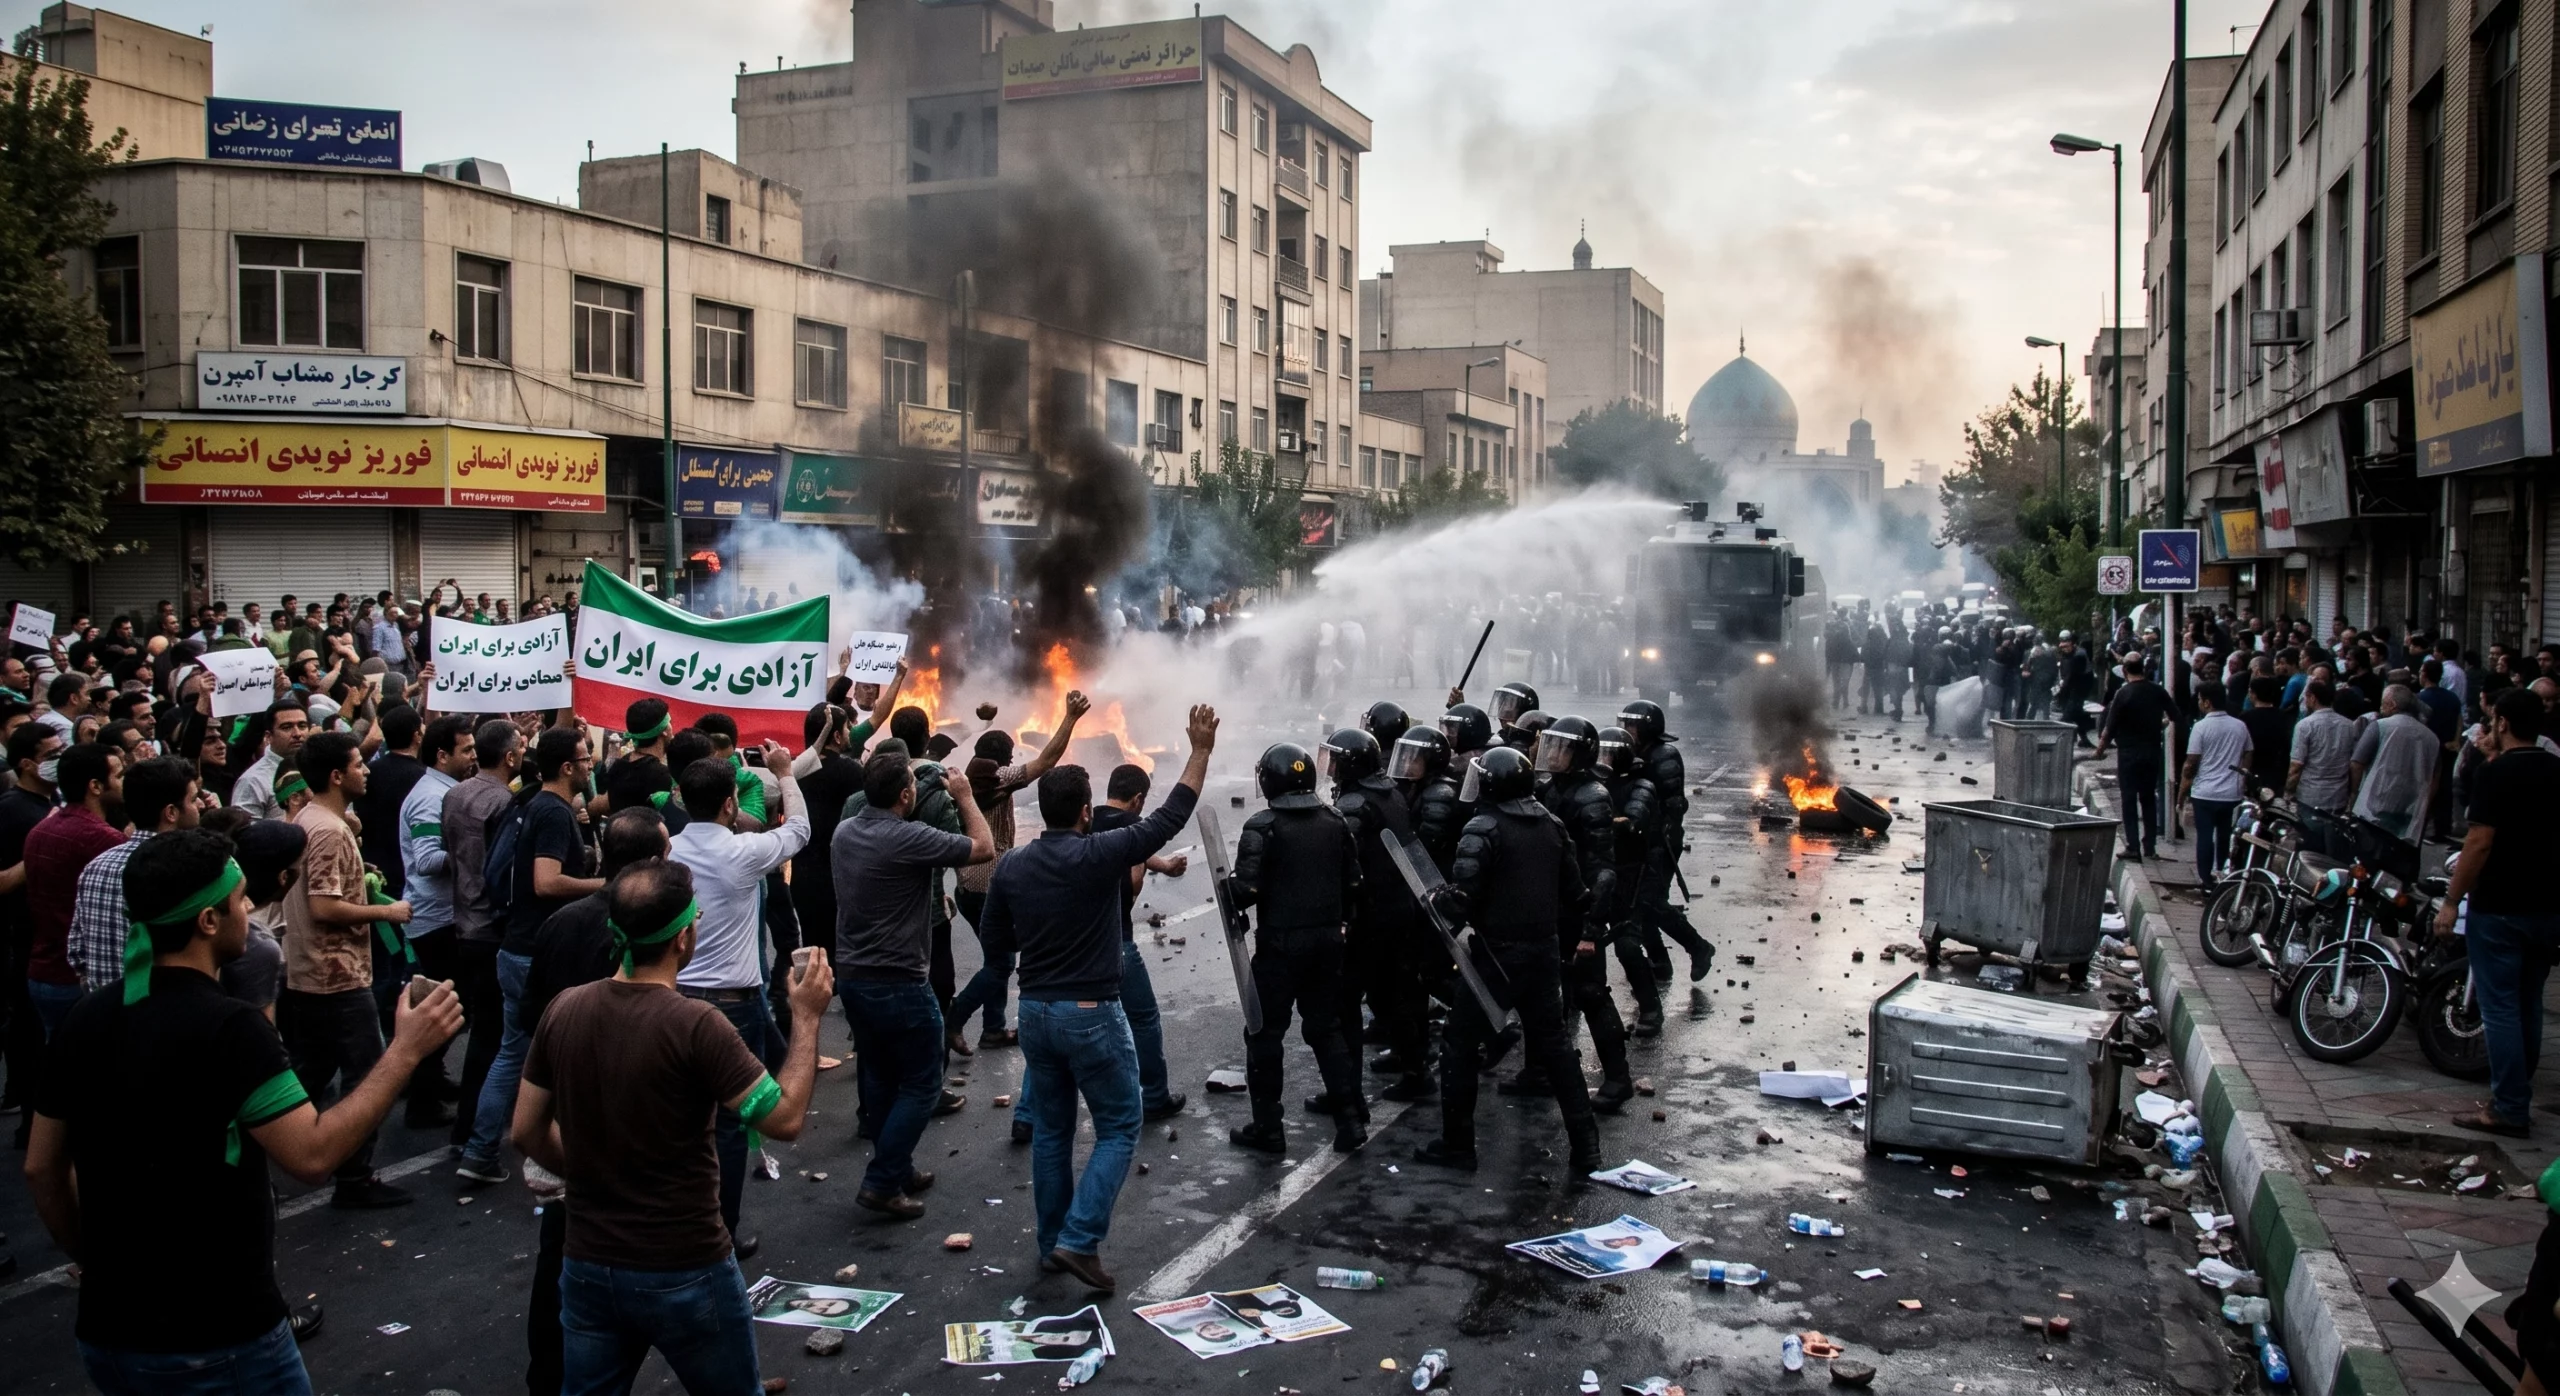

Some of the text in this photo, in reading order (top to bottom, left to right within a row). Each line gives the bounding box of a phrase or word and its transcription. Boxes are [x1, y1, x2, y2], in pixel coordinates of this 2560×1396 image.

[481, 637, 515, 658] برای
[517, 627, 562, 655] آزادی
[584, 630, 819, 698] آزادی برای ایران
[435, 670, 475, 692] ایران
[477, 671, 512, 692] برای
